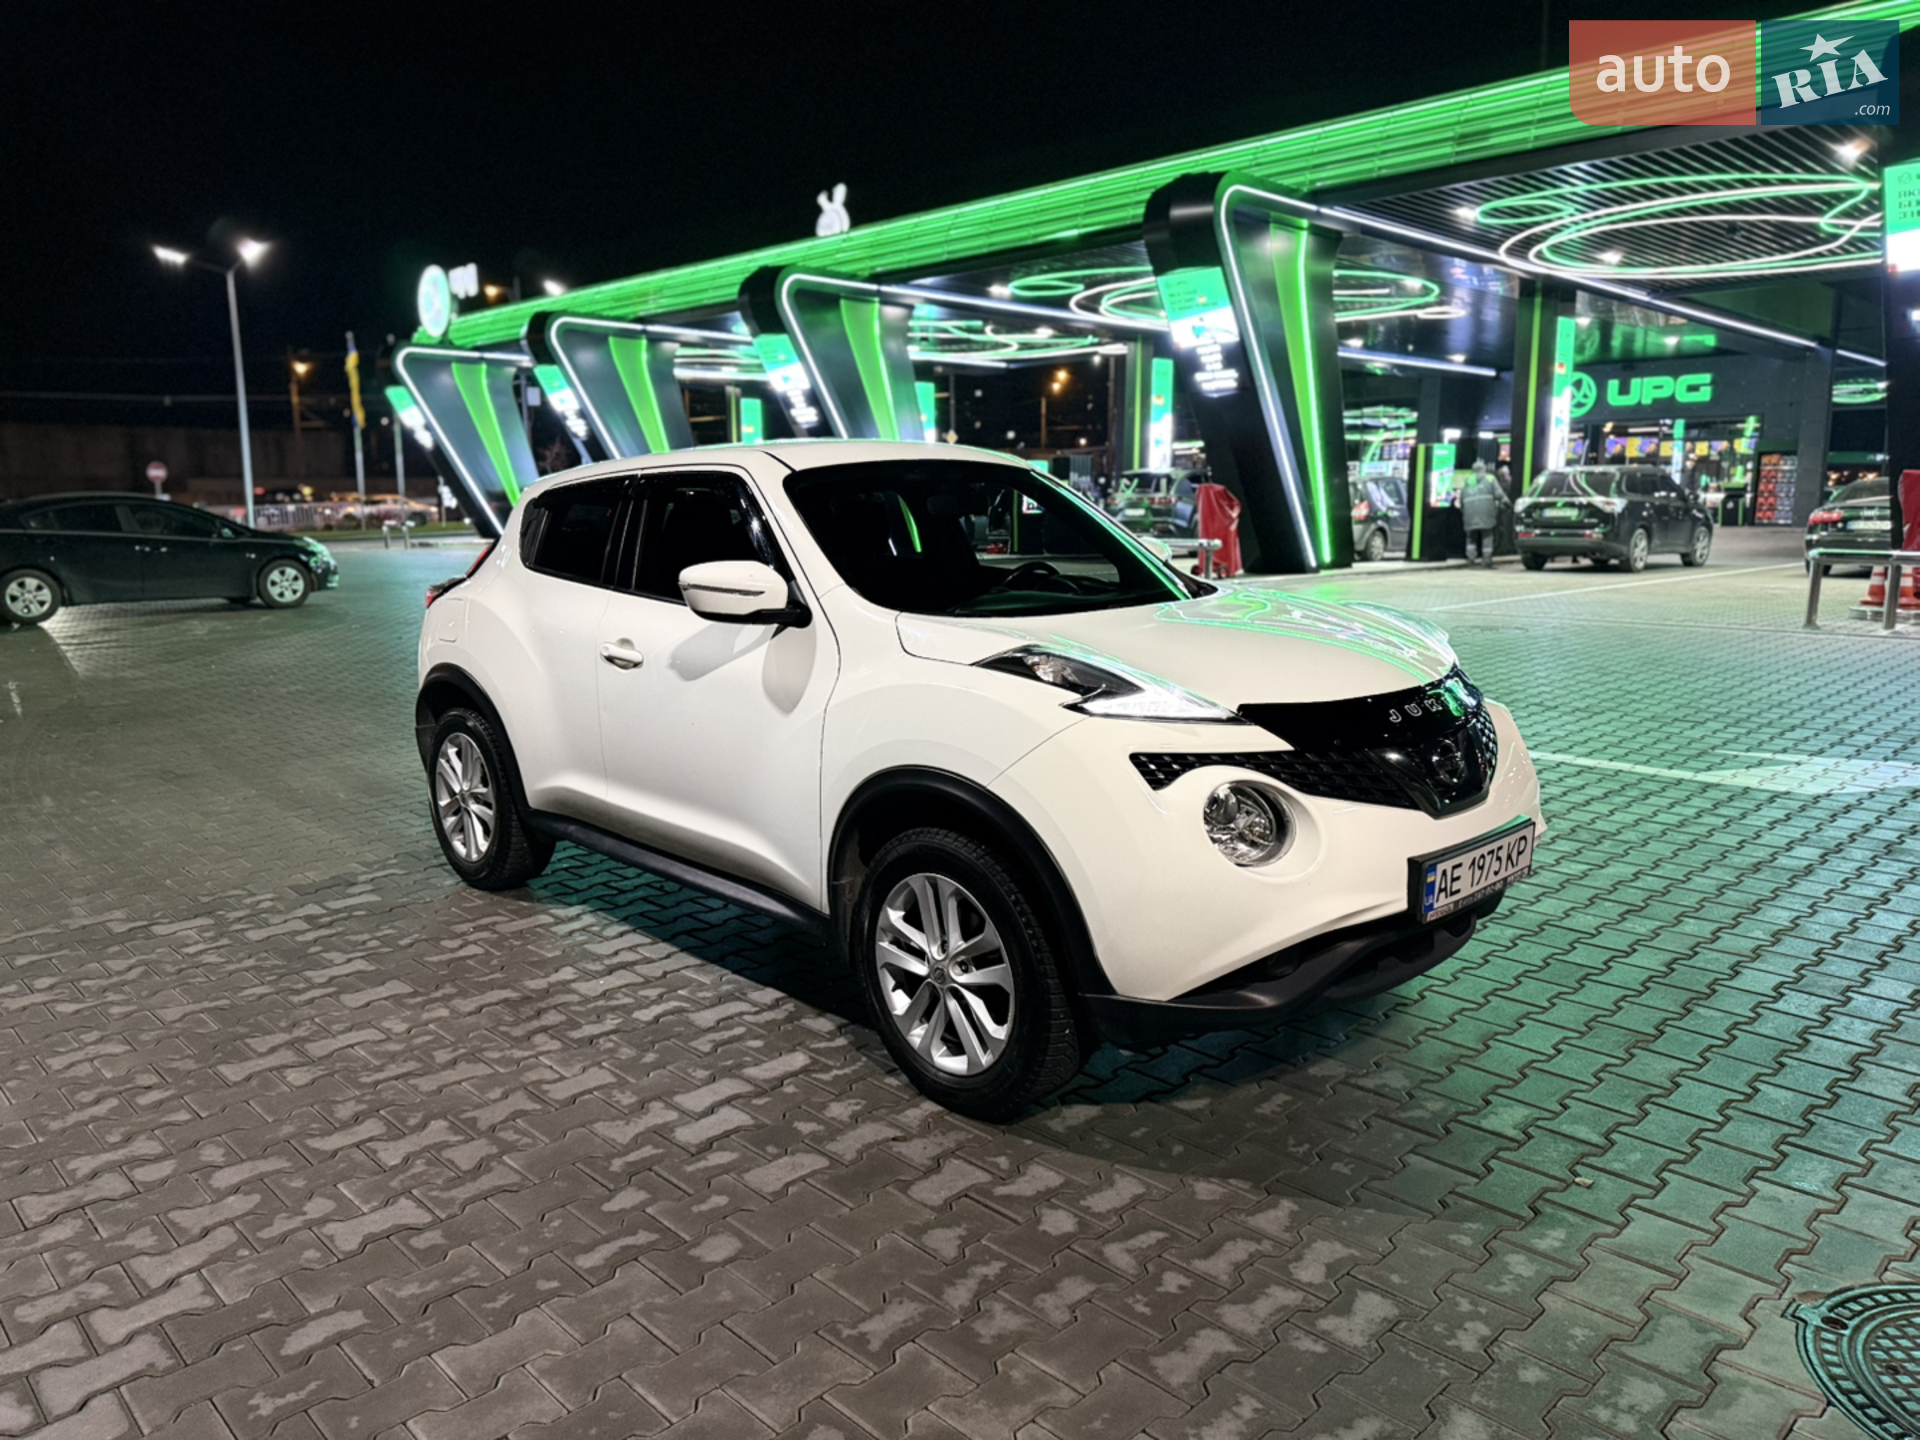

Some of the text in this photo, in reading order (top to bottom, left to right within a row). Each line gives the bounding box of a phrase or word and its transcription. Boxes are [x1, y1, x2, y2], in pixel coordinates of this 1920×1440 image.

[1607, 373, 1712, 407] UPG
[1389, 694, 1452, 723] JUK
[1435, 862, 1463, 903] AE
[1468, 845, 1503, 888] 1975
[1504, 835, 1528, 872] KP
